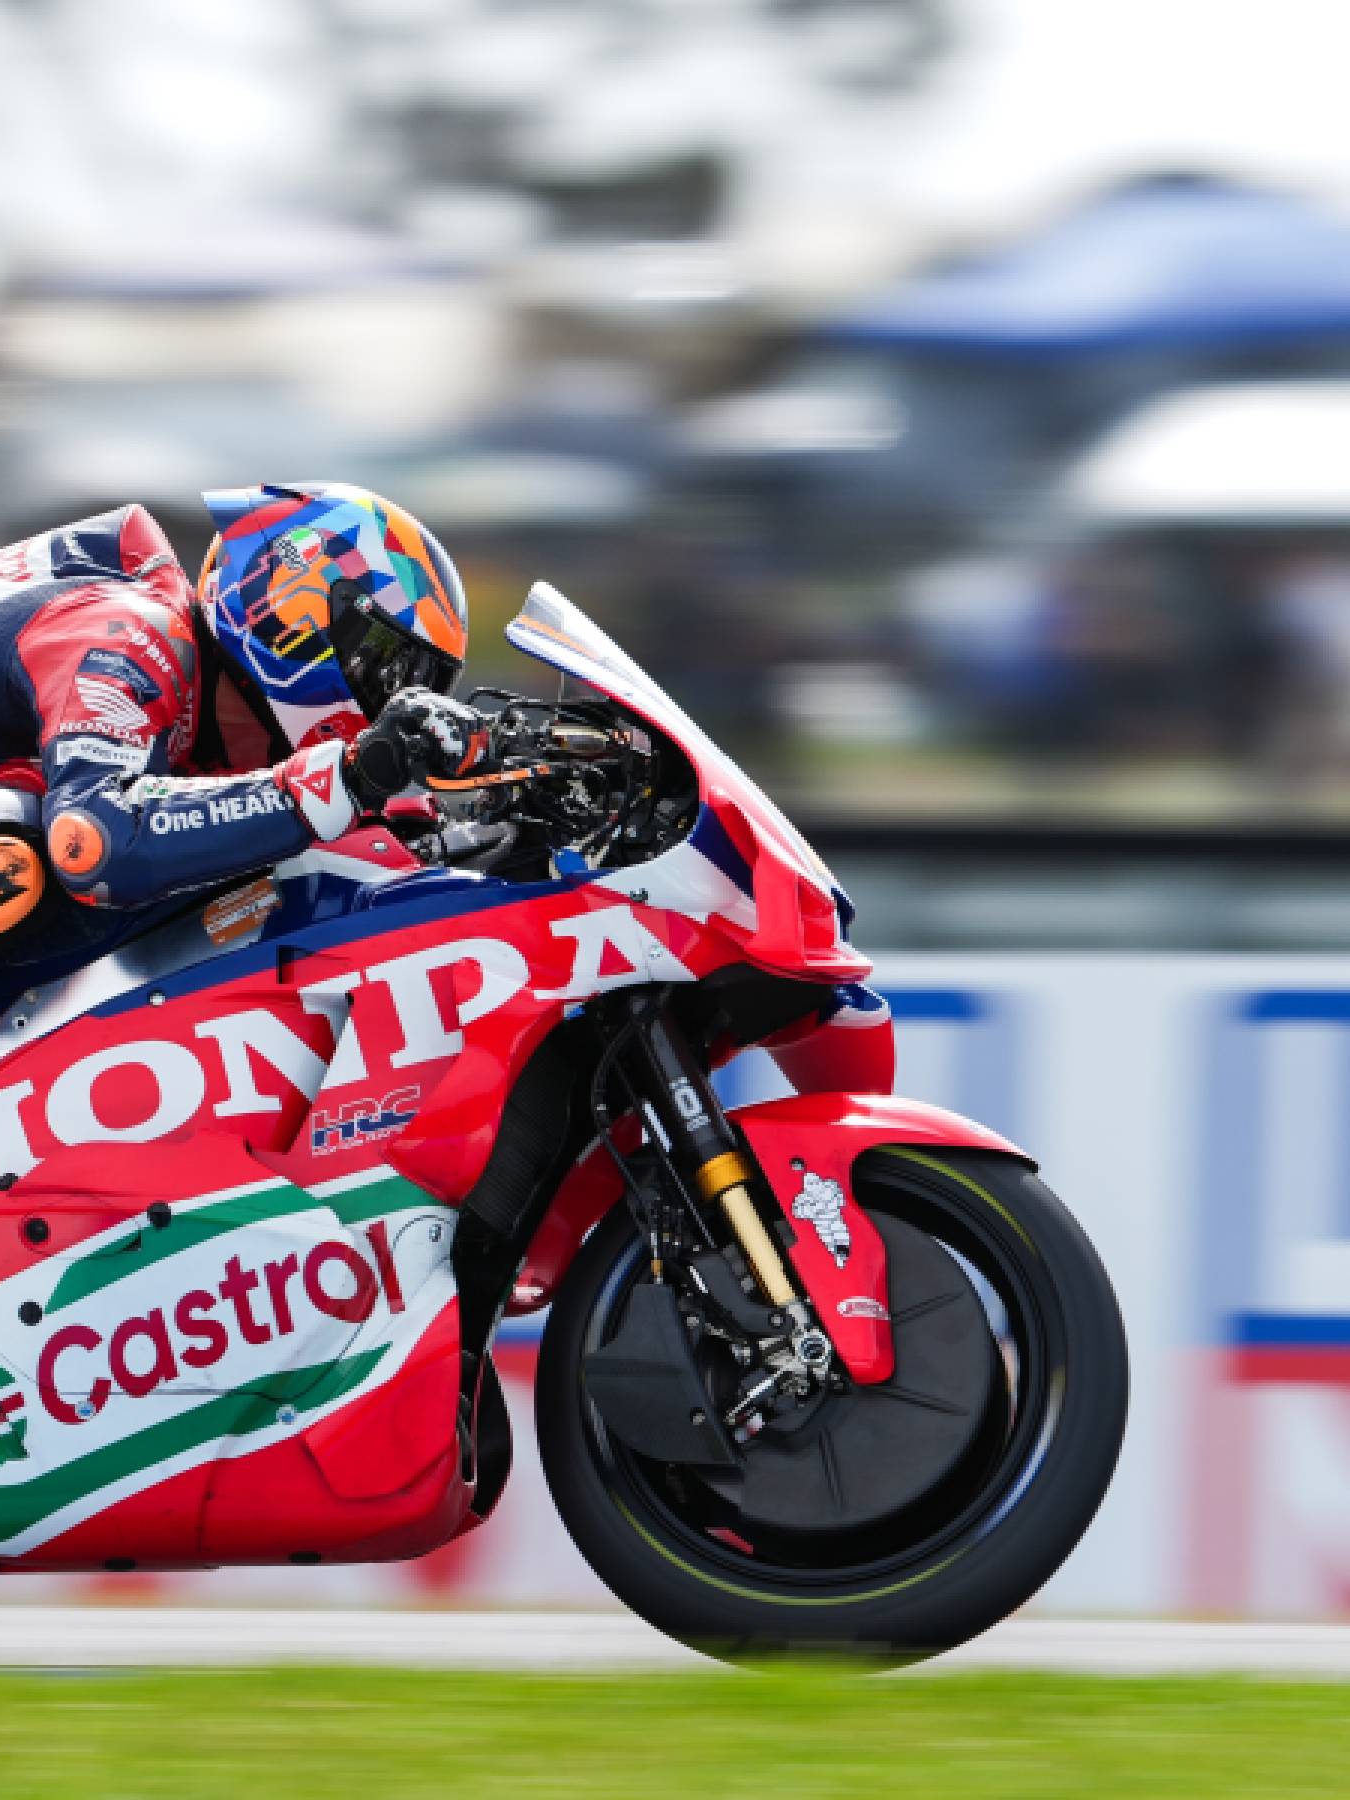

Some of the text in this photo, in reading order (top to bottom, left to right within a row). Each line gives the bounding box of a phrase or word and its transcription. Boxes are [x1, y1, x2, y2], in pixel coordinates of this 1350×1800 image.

[150, 809, 204, 835] One
[311, 1083, 421, 1148] HRC
[37, 1219, 406, 1426] Castrol
